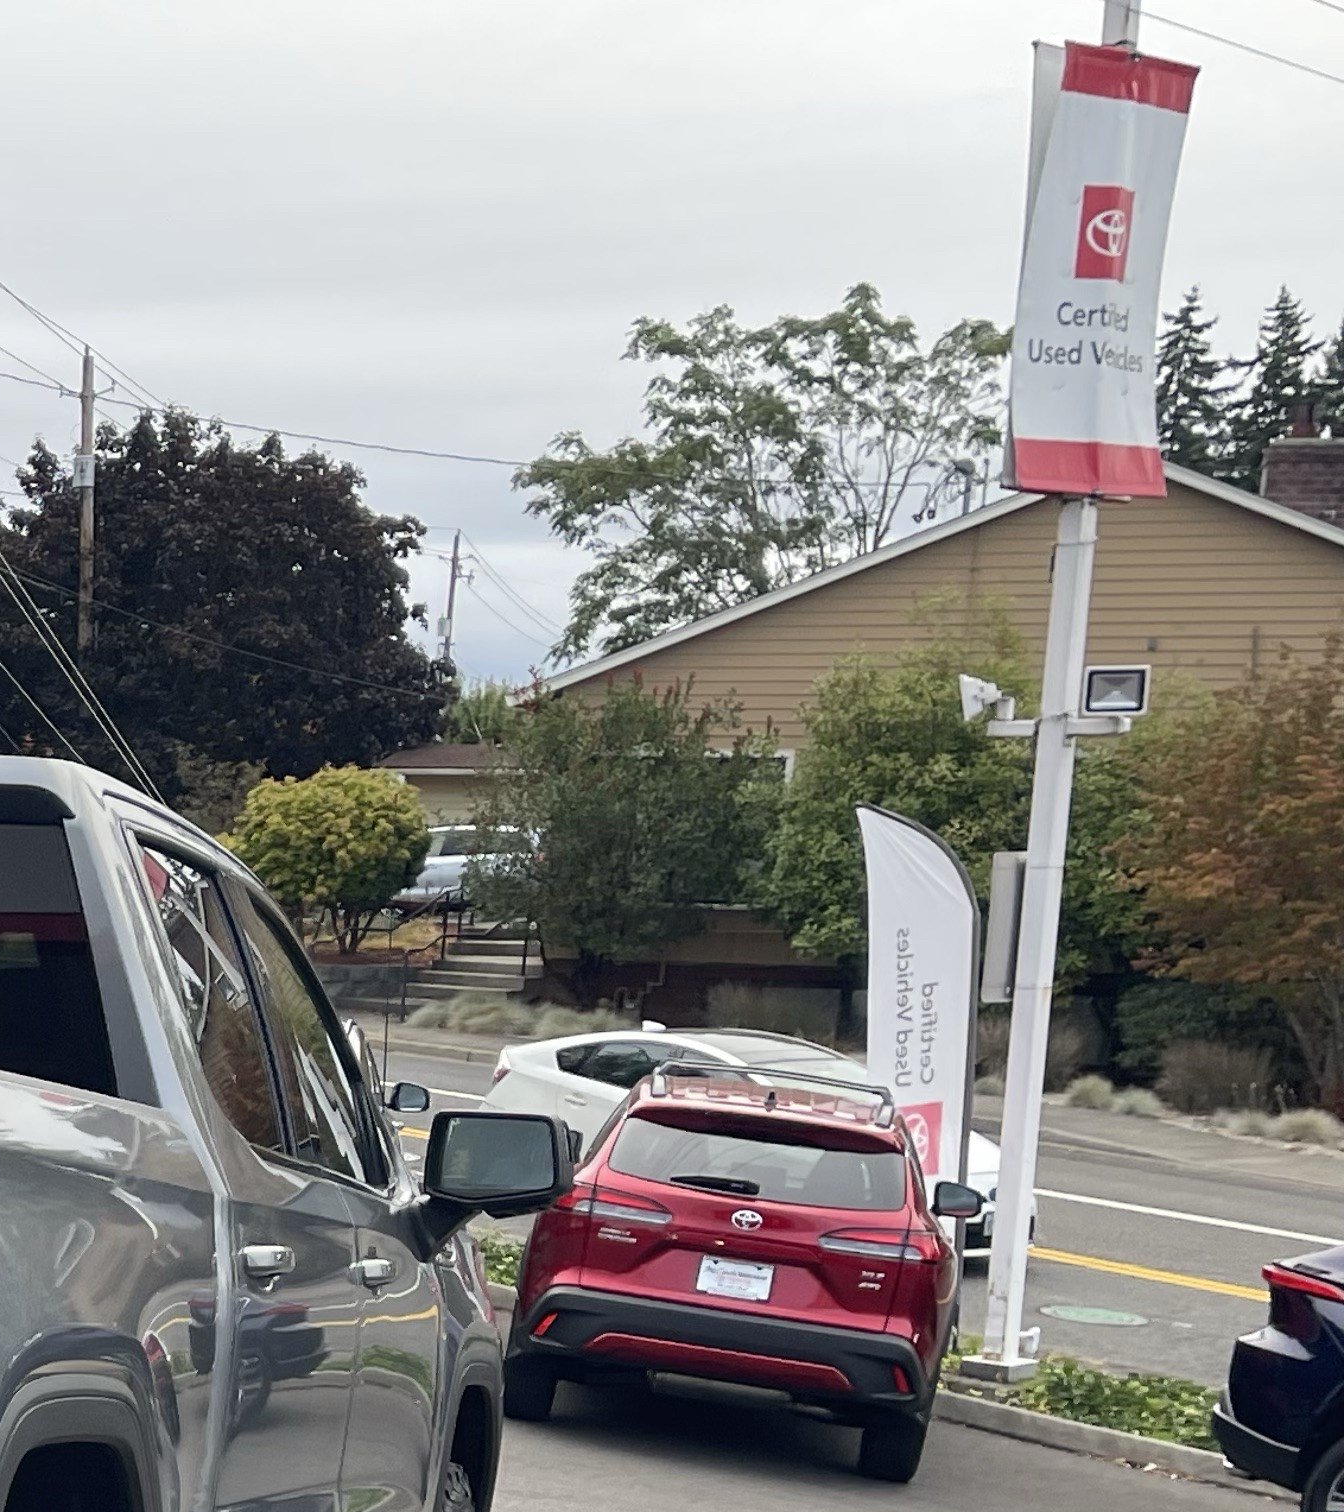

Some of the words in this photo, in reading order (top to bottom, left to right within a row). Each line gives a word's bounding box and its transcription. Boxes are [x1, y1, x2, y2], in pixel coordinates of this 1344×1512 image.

[1057, 302, 1130, 332] Certifed
[1028, 339, 1083, 365] Used
[1090, 341, 1143, 373] Veicles
